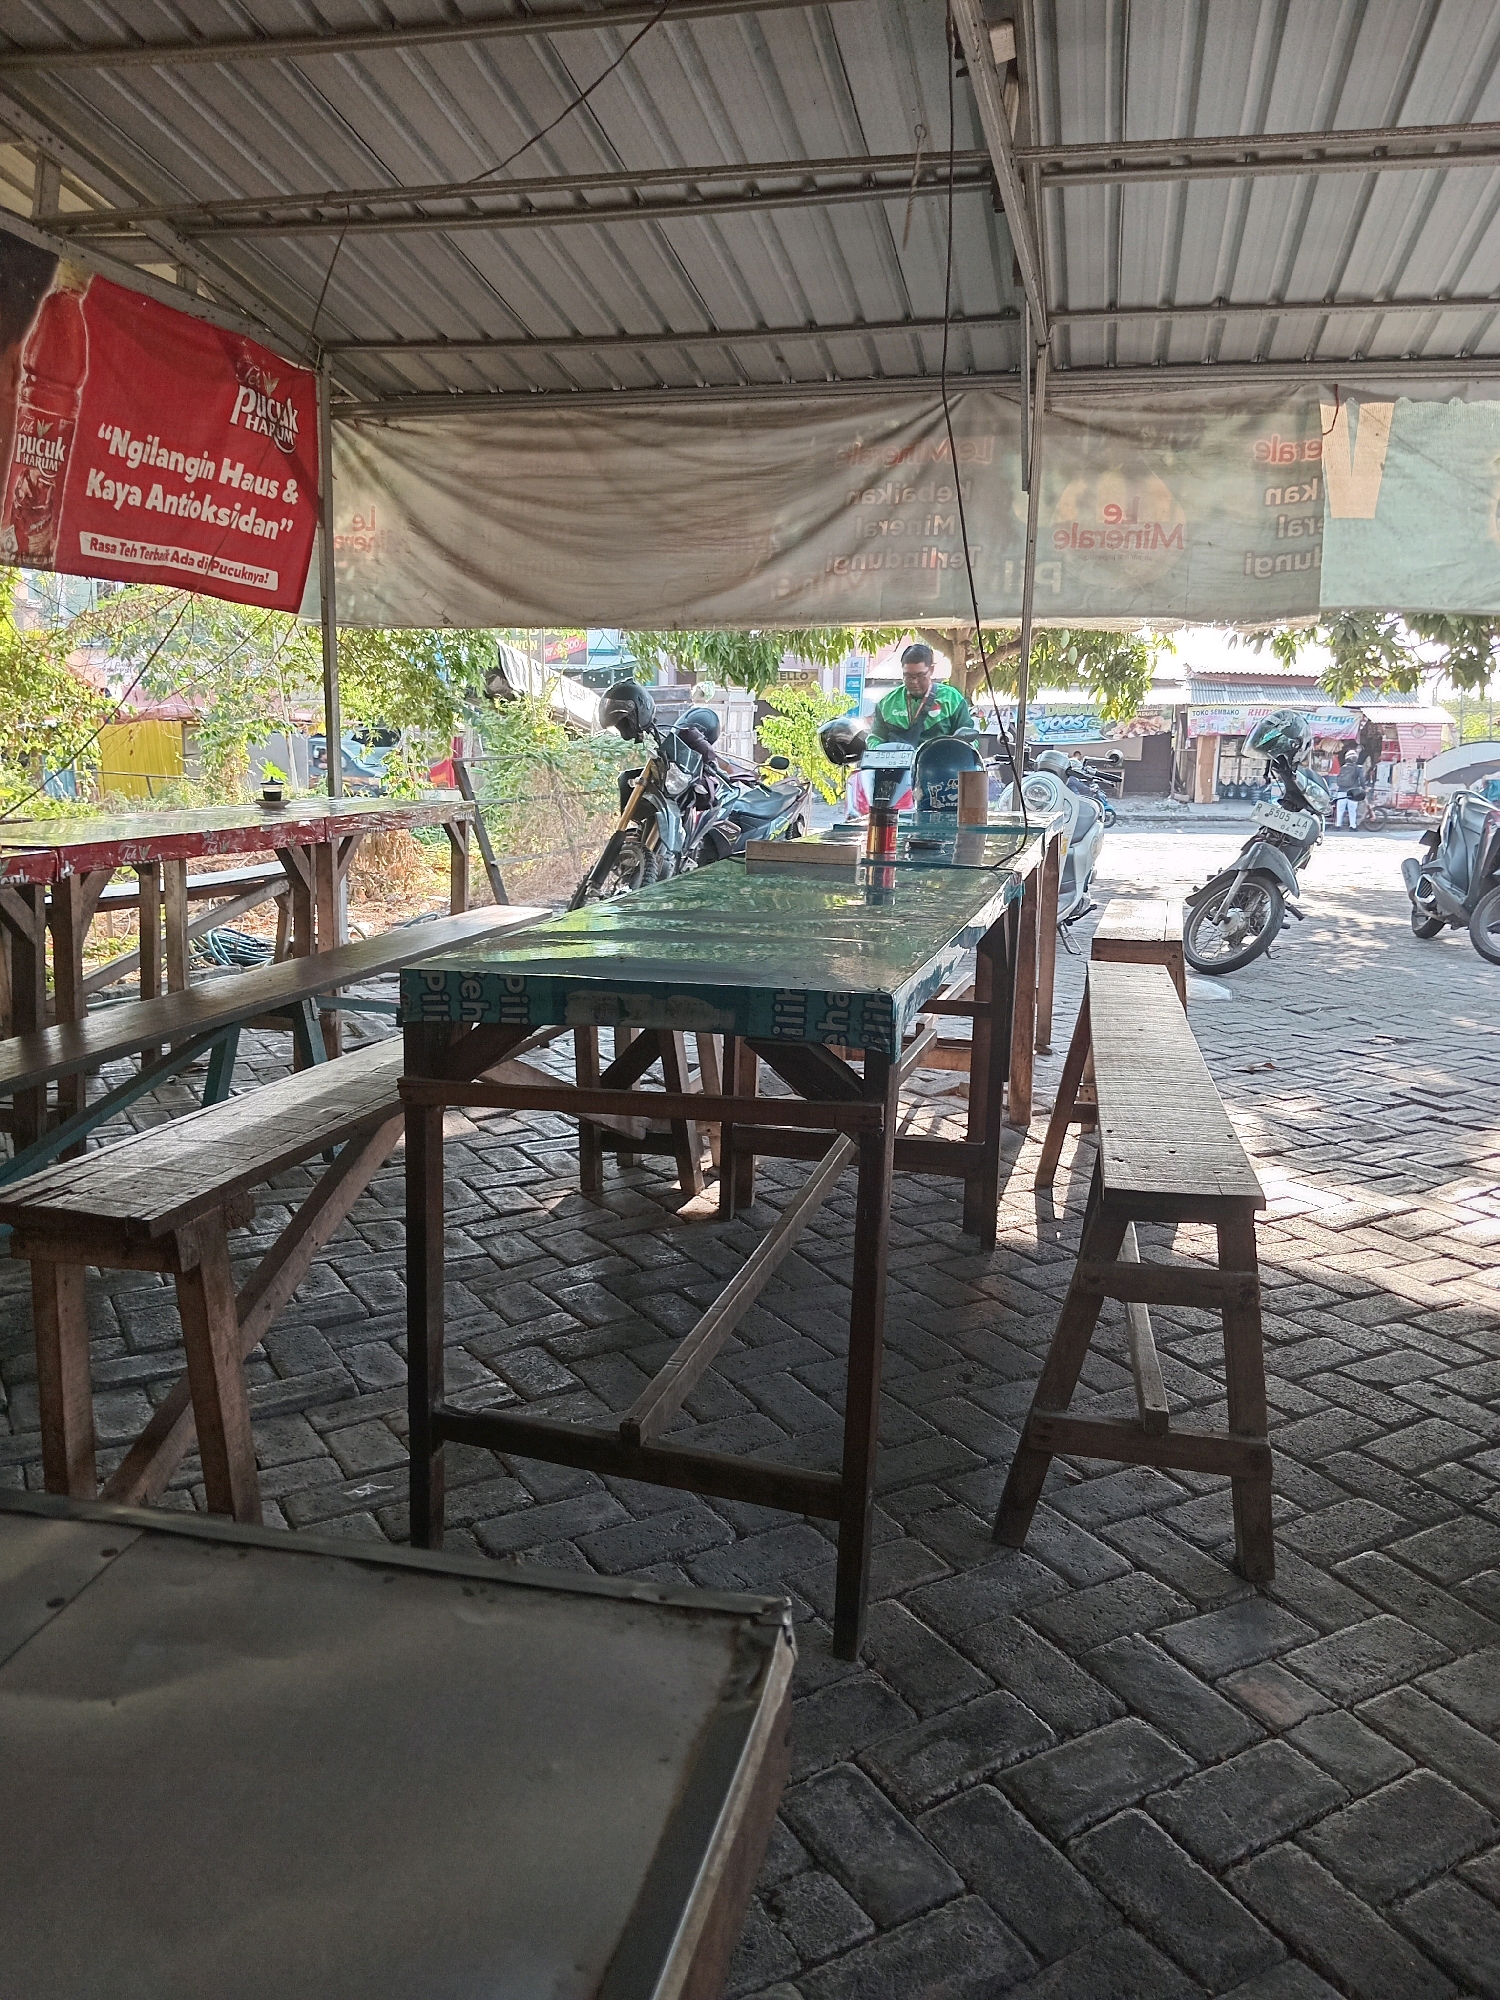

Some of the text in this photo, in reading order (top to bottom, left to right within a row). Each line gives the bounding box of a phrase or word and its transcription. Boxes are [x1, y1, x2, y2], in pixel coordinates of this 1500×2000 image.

[245, 414, 297, 453] HARUM
[22, 452, 60, 478] HARUM
[219, 457, 279, 501] Haus
[282, 478, 299, 505] &
[86, 468, 141, 511] Kaya
[90, 536, 116, 555] Rasa
[119, 541, 138, 558] Teh
[170, 550, 195, 566] Ada
[197, 555, 208, 569] di
[210, 560, 270, 585] Pucuknya!
[776, 671, 809, 681] ELLO
[1210, 708, 1240, 716] SEMBAKO
[1256, 803, 1308, 830] R 6505 LA
